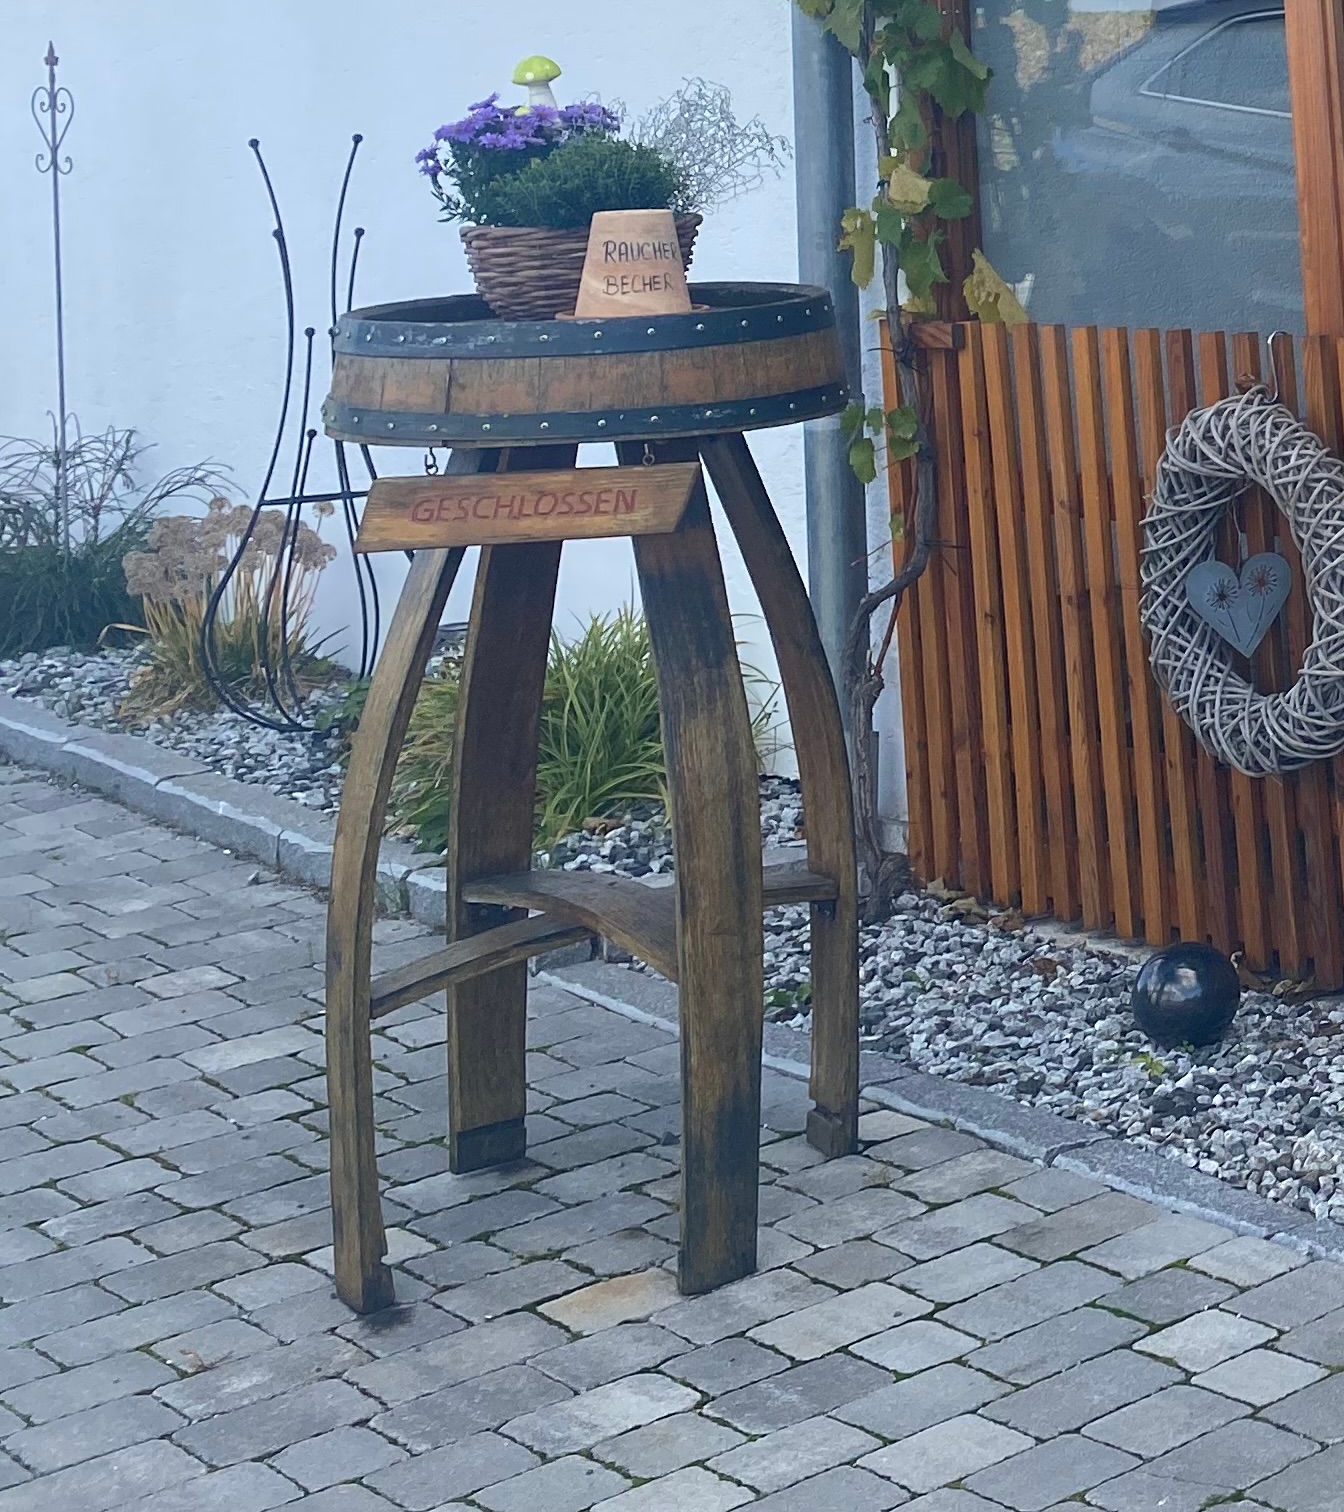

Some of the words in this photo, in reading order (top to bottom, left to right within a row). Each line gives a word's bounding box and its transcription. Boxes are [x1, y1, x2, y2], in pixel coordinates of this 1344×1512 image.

[602, 240, 680, 264] RAUCHER
[602, 272, 674, 296] BECHER
[412, 489, 638, 523] GESCHLOSSEN
